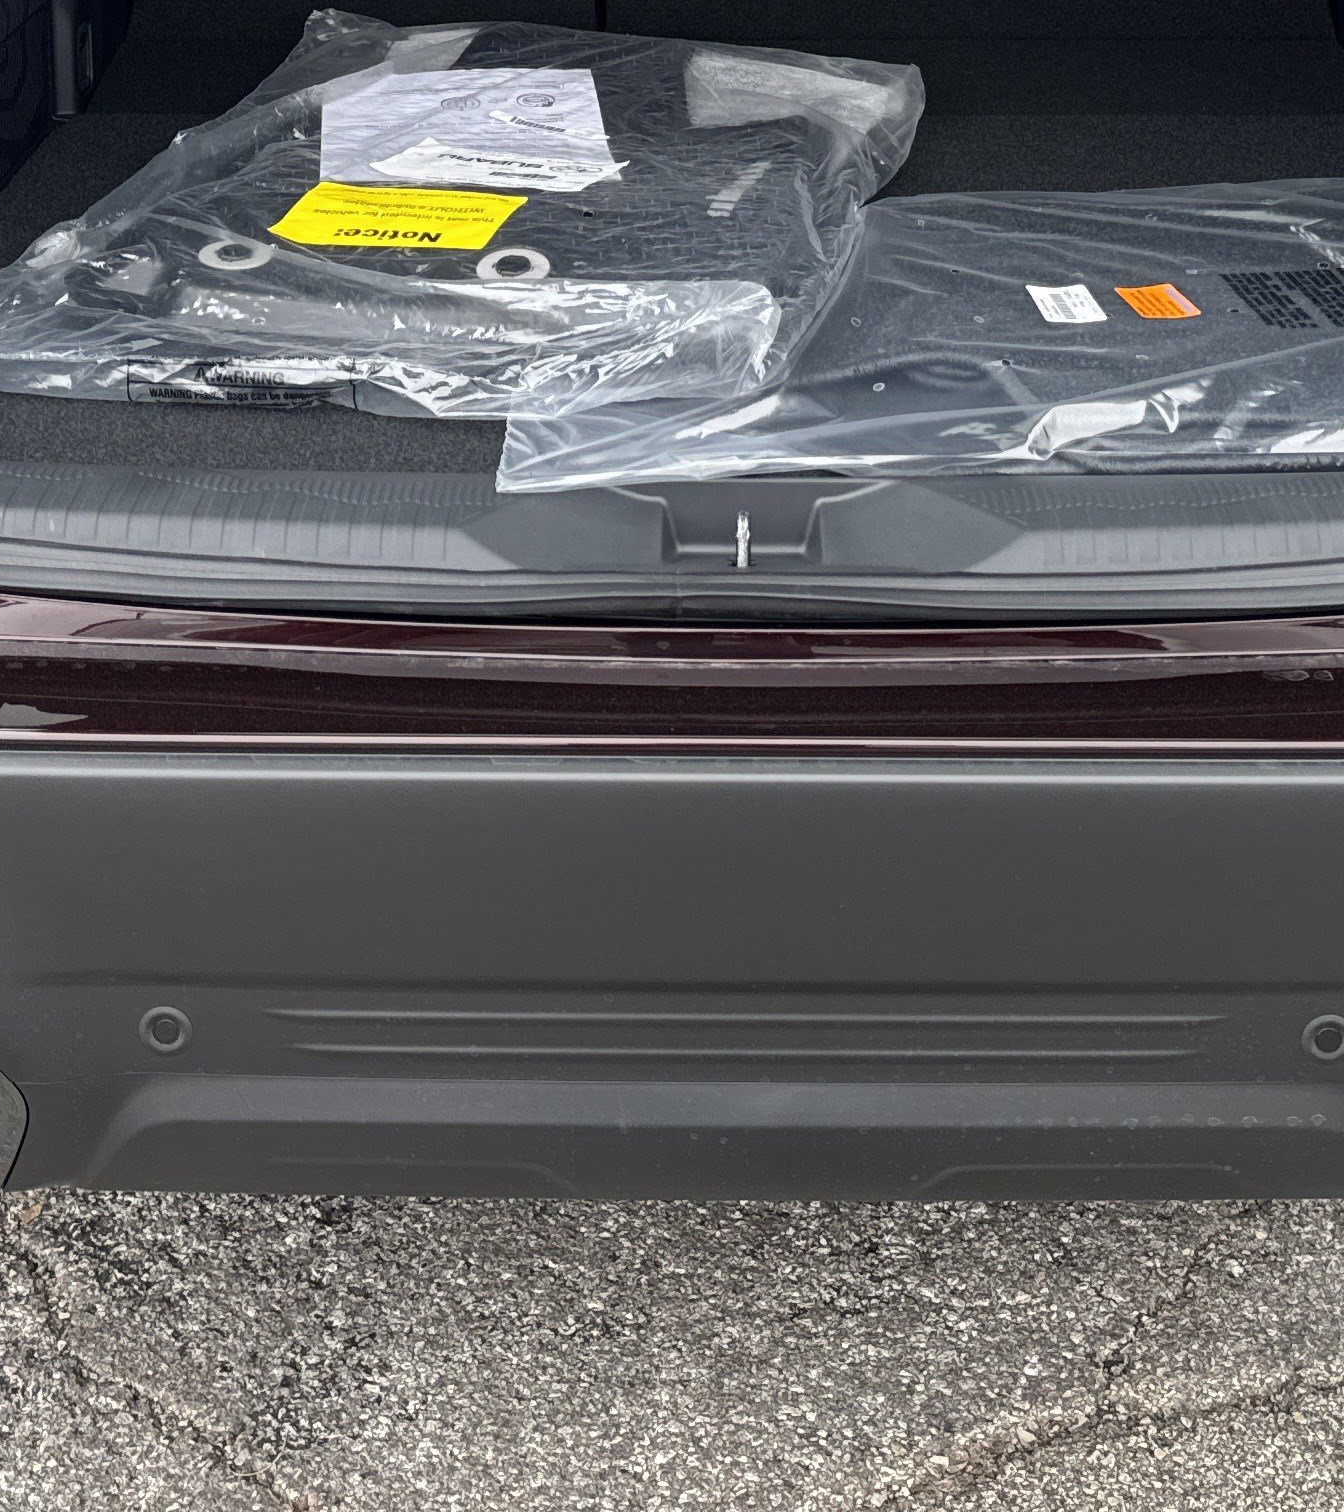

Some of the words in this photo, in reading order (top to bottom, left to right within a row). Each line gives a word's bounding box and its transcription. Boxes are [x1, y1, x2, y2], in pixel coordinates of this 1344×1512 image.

[437, 153, 544, 168] SUBARU
[426, 206, 485, 214] WITHOUT
[333, 228, 442, 243] Notice:
[208, 369, 284, 385] WARNING
[149, 388, 192, 399] WARNING
[226, 391, 249, 402] bags
